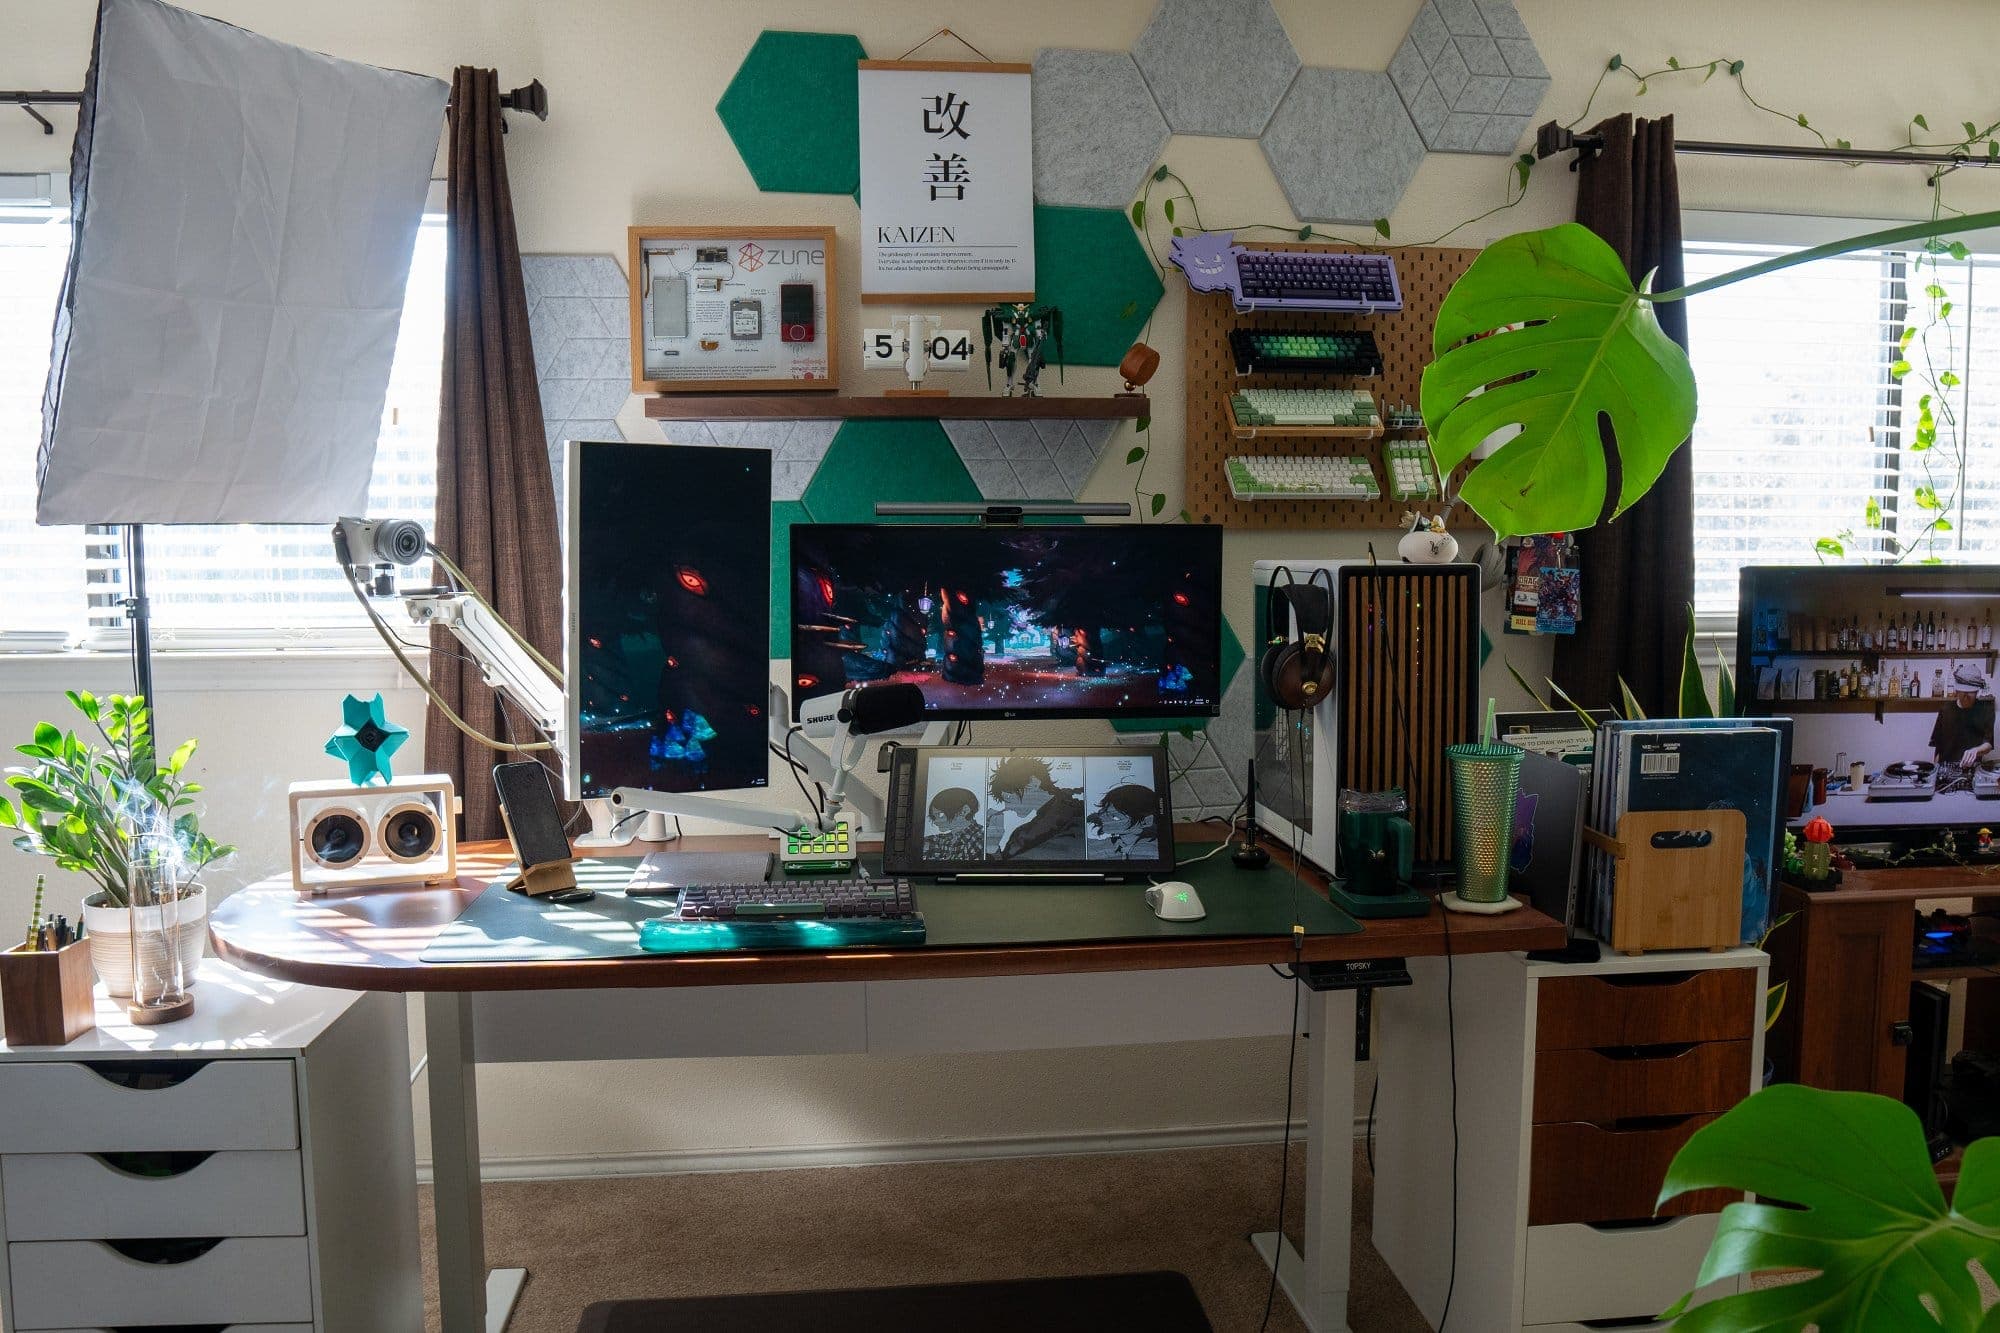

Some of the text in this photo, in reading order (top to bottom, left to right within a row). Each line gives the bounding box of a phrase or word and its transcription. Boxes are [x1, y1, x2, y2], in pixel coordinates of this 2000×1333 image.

[921, 92, 971, 201] 改善
[877, 226, 956, 243] KAIZEN
[767, 249, 825, 265] zune
[875, 335, 968, 360] 5 04
[807, 714, 835, 724] SHURE
[1346, 962, 1370, 970] TOPSKY
